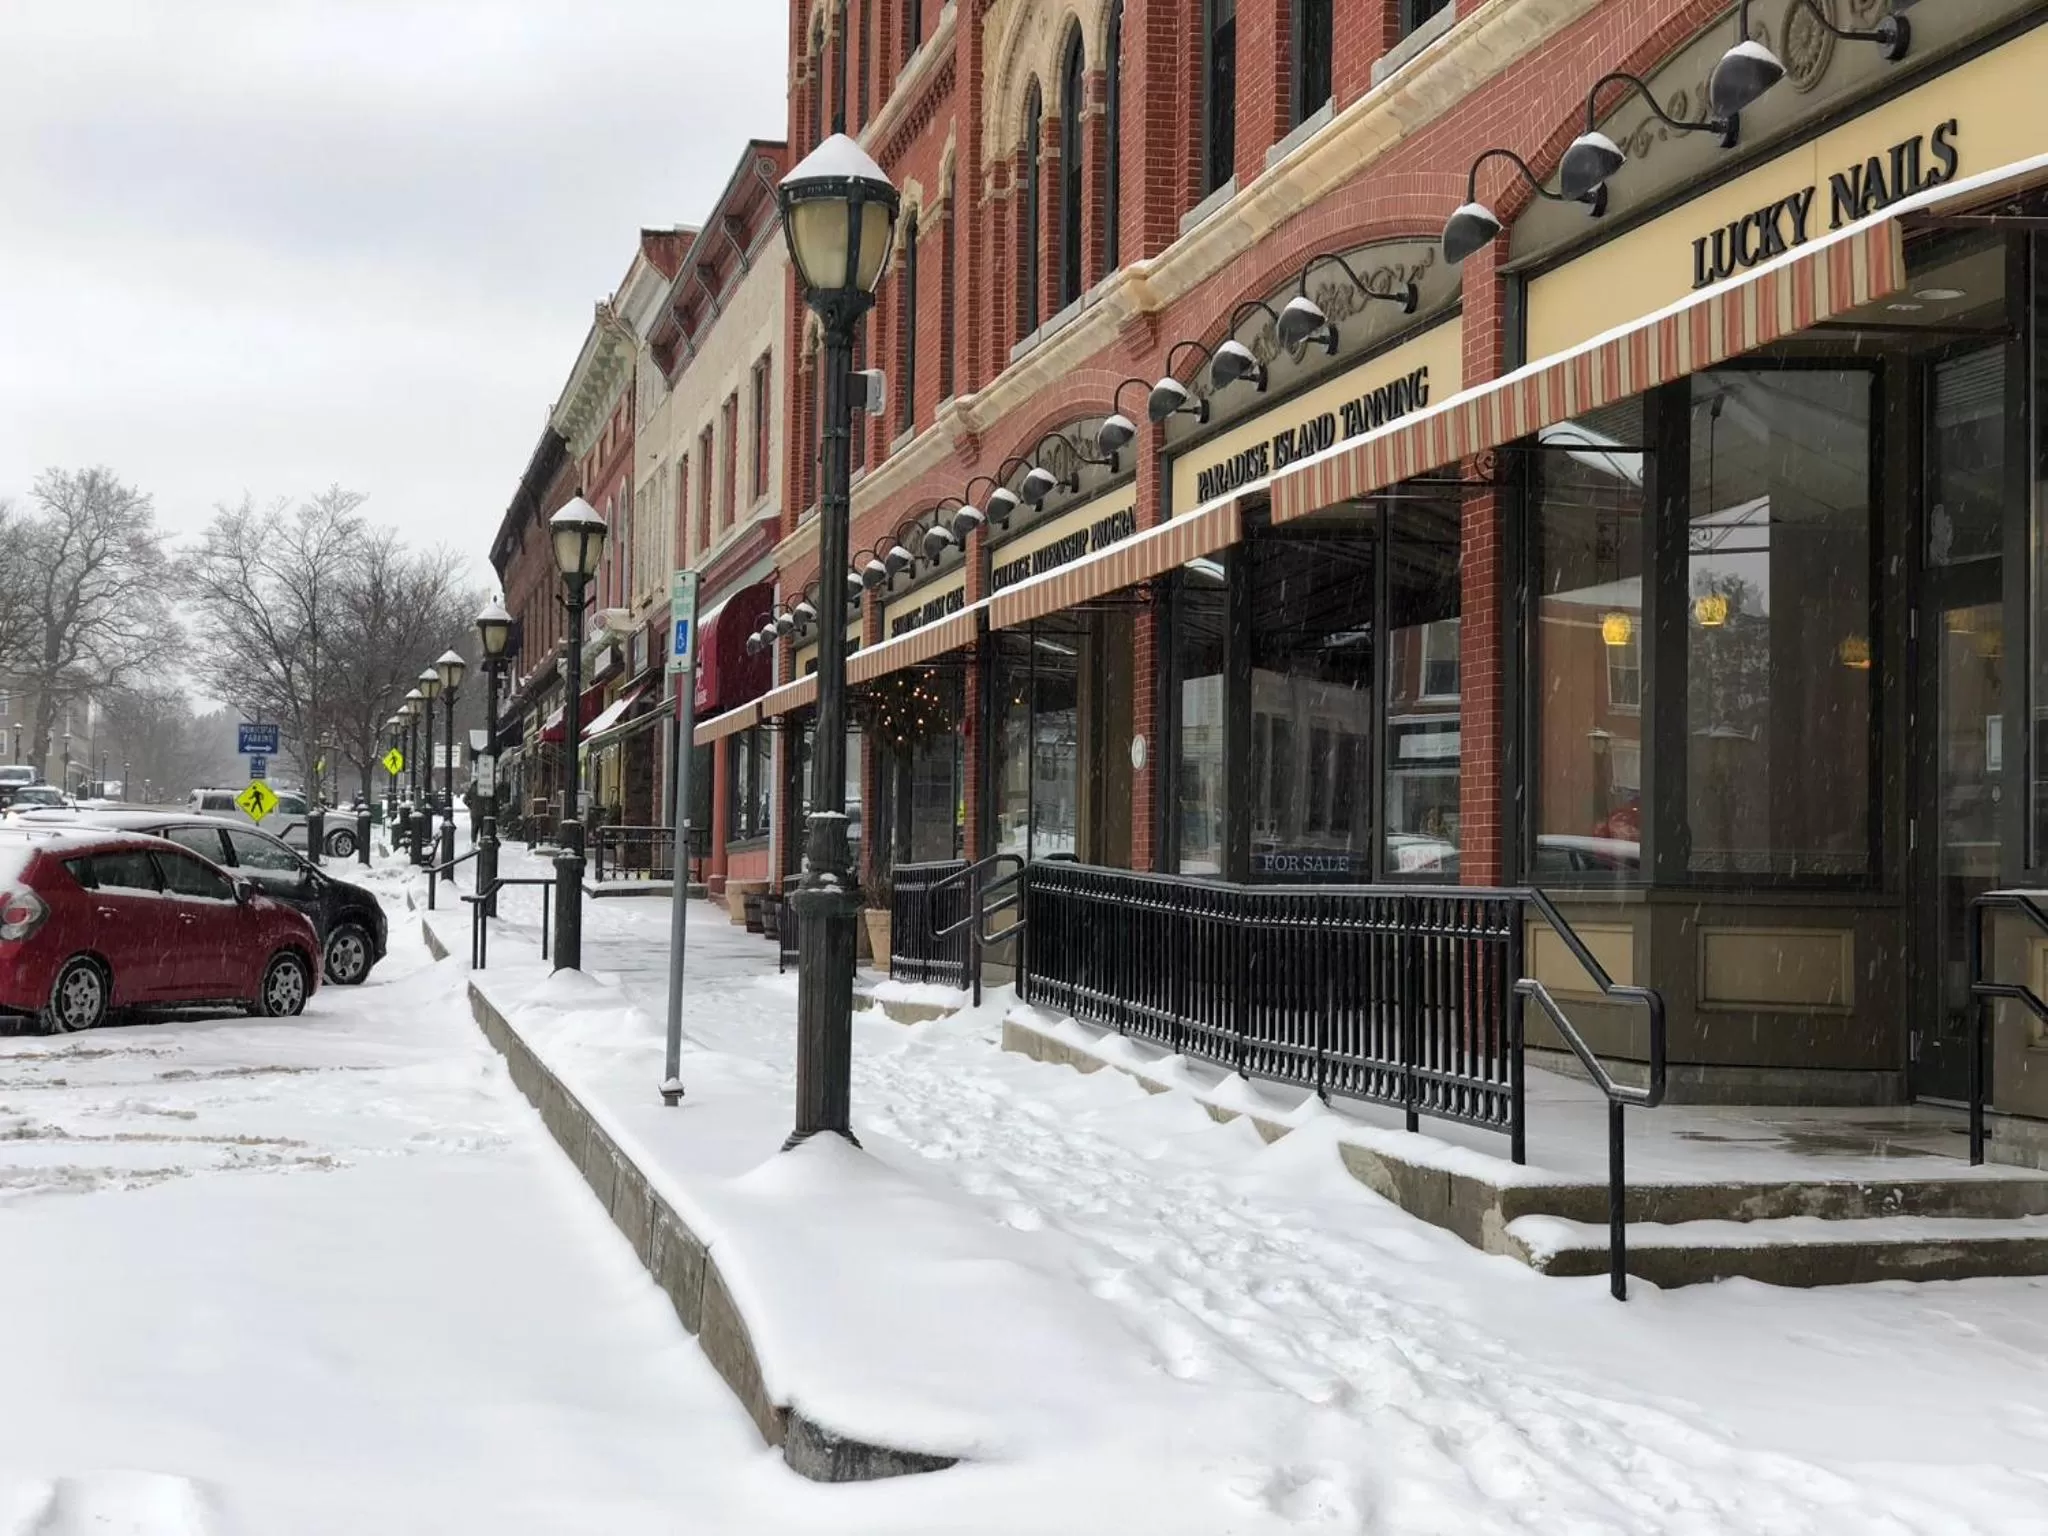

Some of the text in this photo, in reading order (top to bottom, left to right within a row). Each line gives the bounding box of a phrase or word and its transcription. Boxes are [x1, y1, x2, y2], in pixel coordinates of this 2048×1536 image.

[1692, 118, 1957, 289] LUCKY NAILS
[1197, 365, 1429, 504] PARADISE ISLAND TANNING
[992, 506, 1137, 590] COLLEGE INTERNSHIP PROGRA
[1264, 854, 1349, 872] FOR SALE
